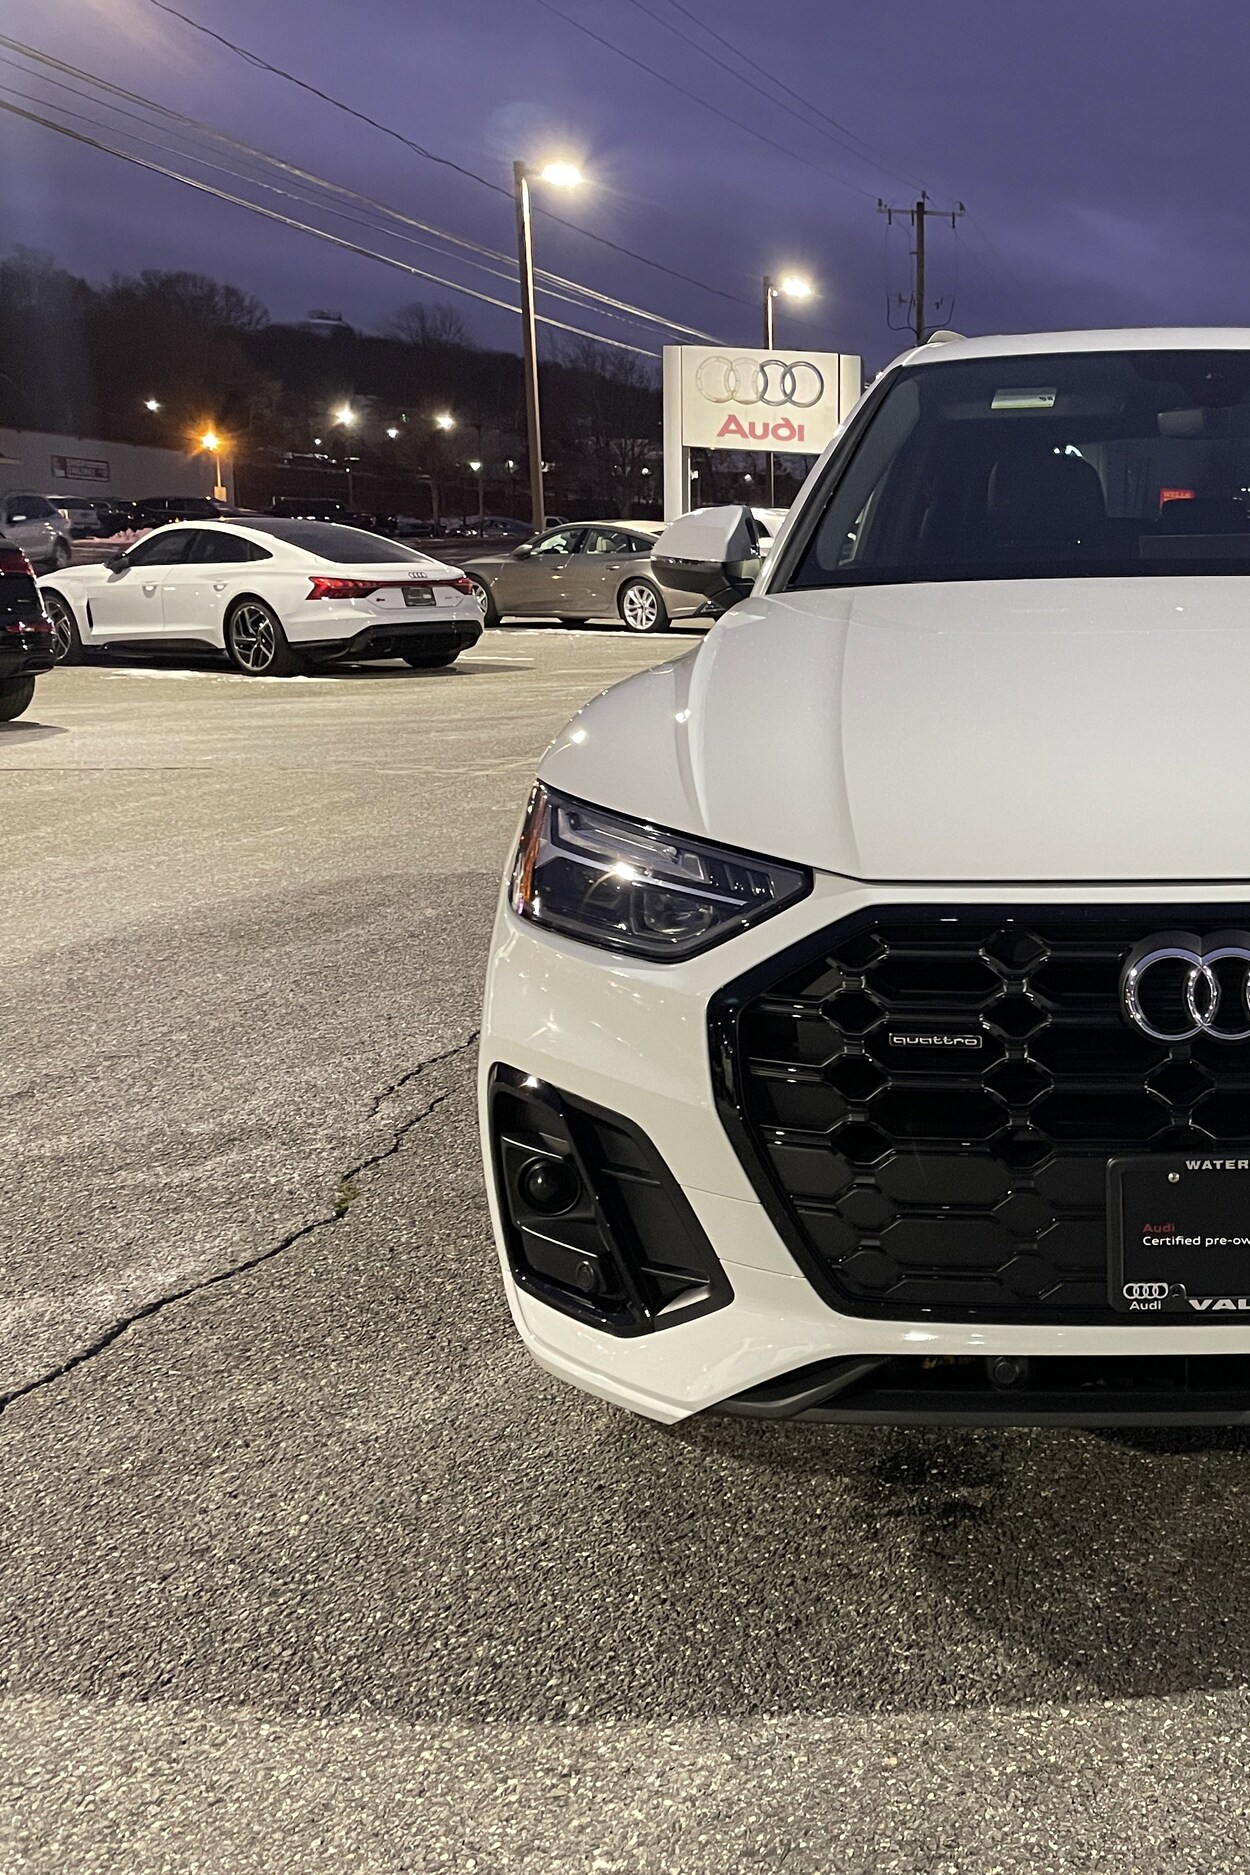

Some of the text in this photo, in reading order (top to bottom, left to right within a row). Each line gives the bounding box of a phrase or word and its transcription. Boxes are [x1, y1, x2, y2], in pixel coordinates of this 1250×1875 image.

[716, 413, 806, 441] Audi
[893, 1036, 977, 1046] quattro
[1143, 1223, 1175, 1233] Audi
[1143, 1235, 1201, 1246] Certified
[1129, 1300, 1162, 1310] Audi
